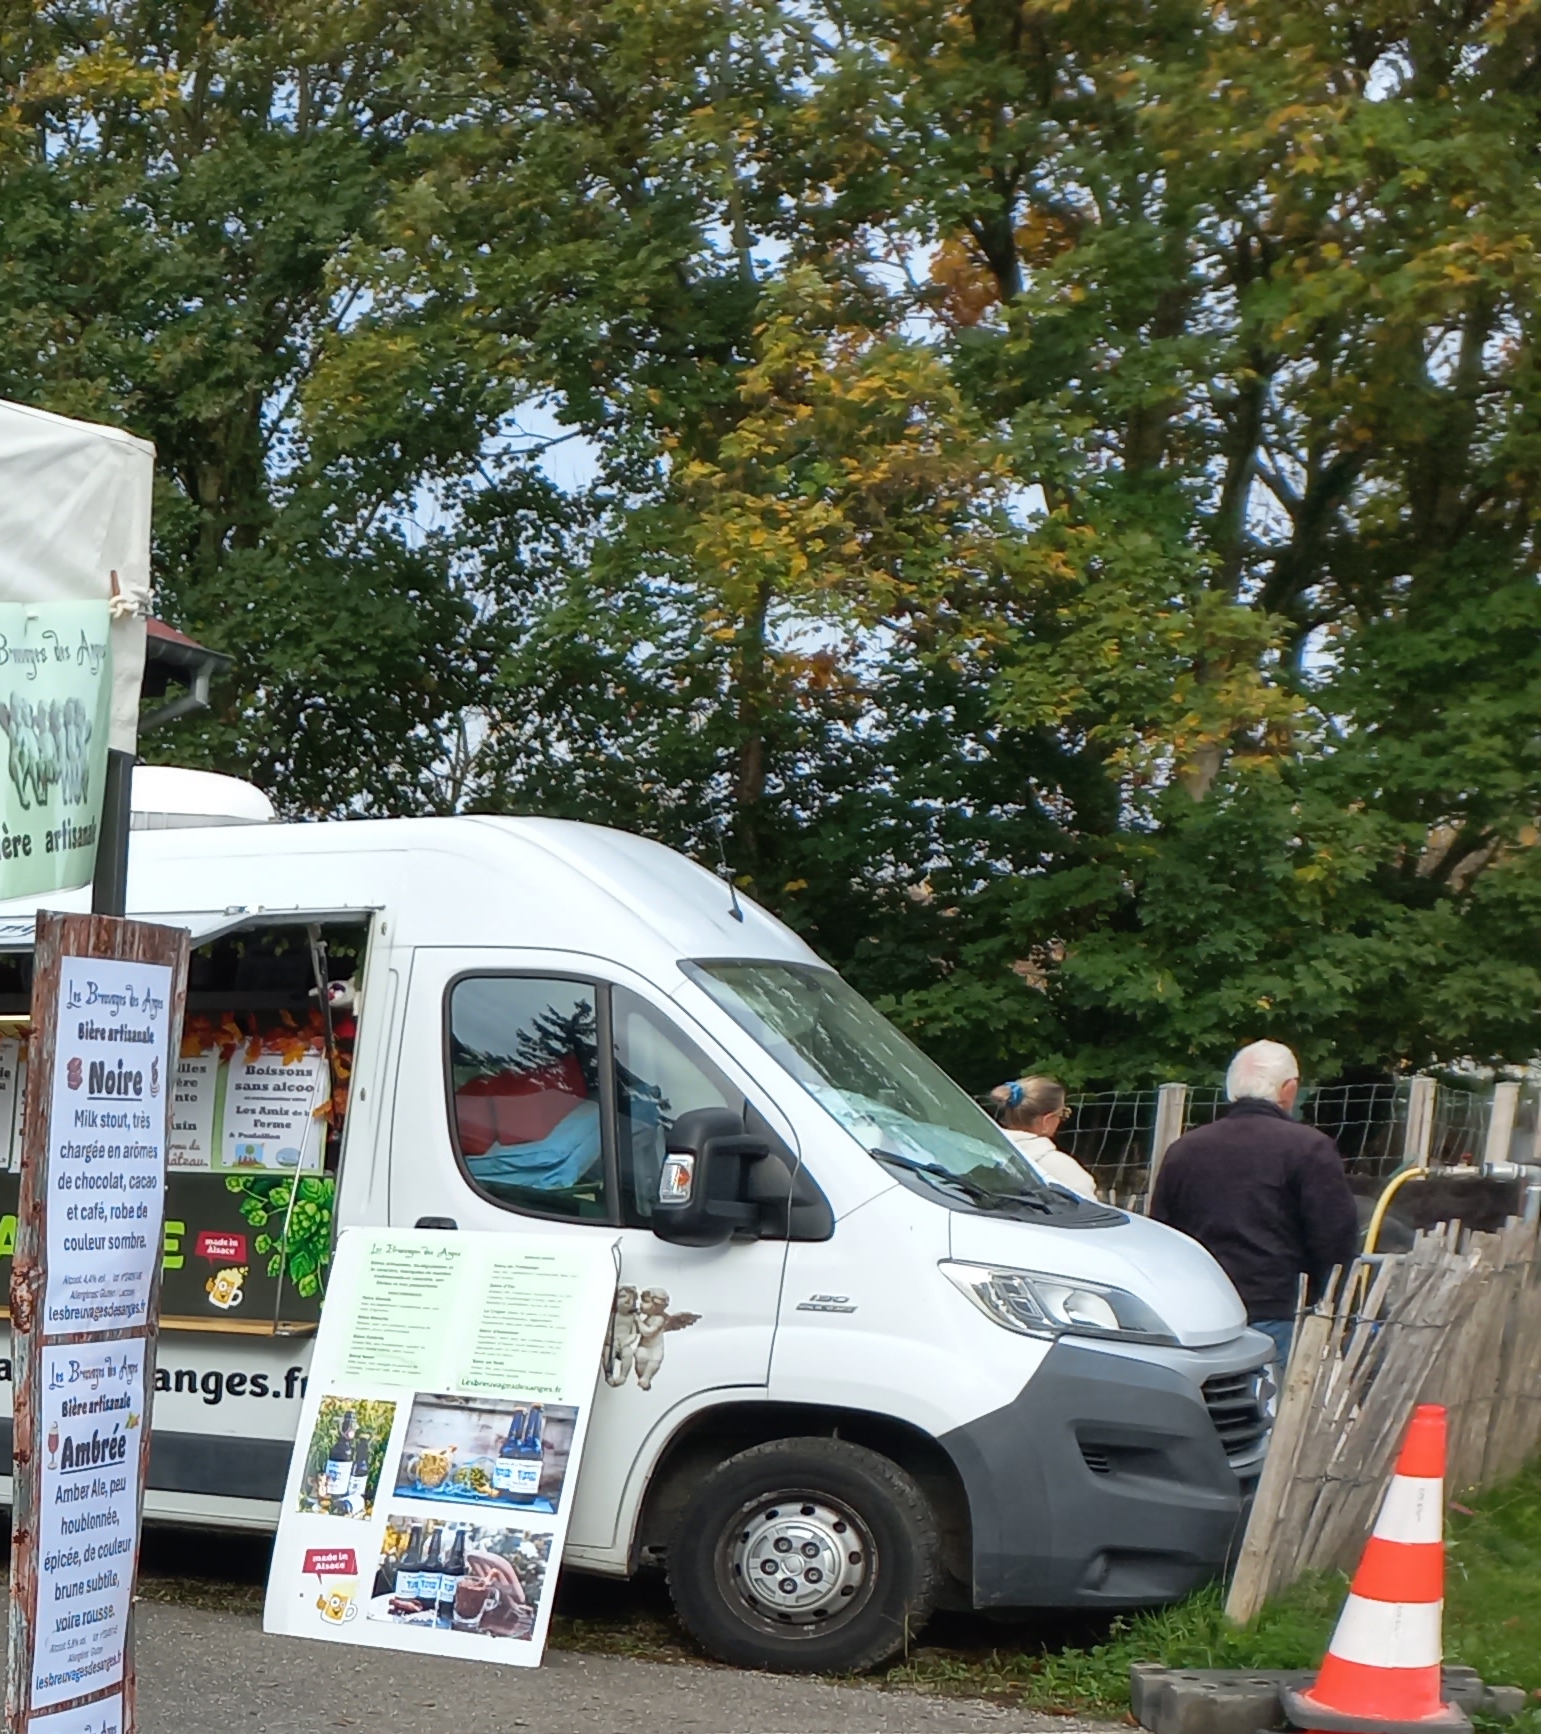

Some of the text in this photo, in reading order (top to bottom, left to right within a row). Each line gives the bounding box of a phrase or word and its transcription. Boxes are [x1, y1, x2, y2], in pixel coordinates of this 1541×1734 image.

[88, 1058, 143, 1097] Noire
[245, 1065, 313, 1076] Boissons
[235, 1082, 269, 1091] sans
[75, 1109, 151, 1131] Milk stout, très
[61, 1423, 126, 1471] Ambrée
[61, 1509, 120, 1536] houblonnée,
[312, 1553, 337, 1562] made
